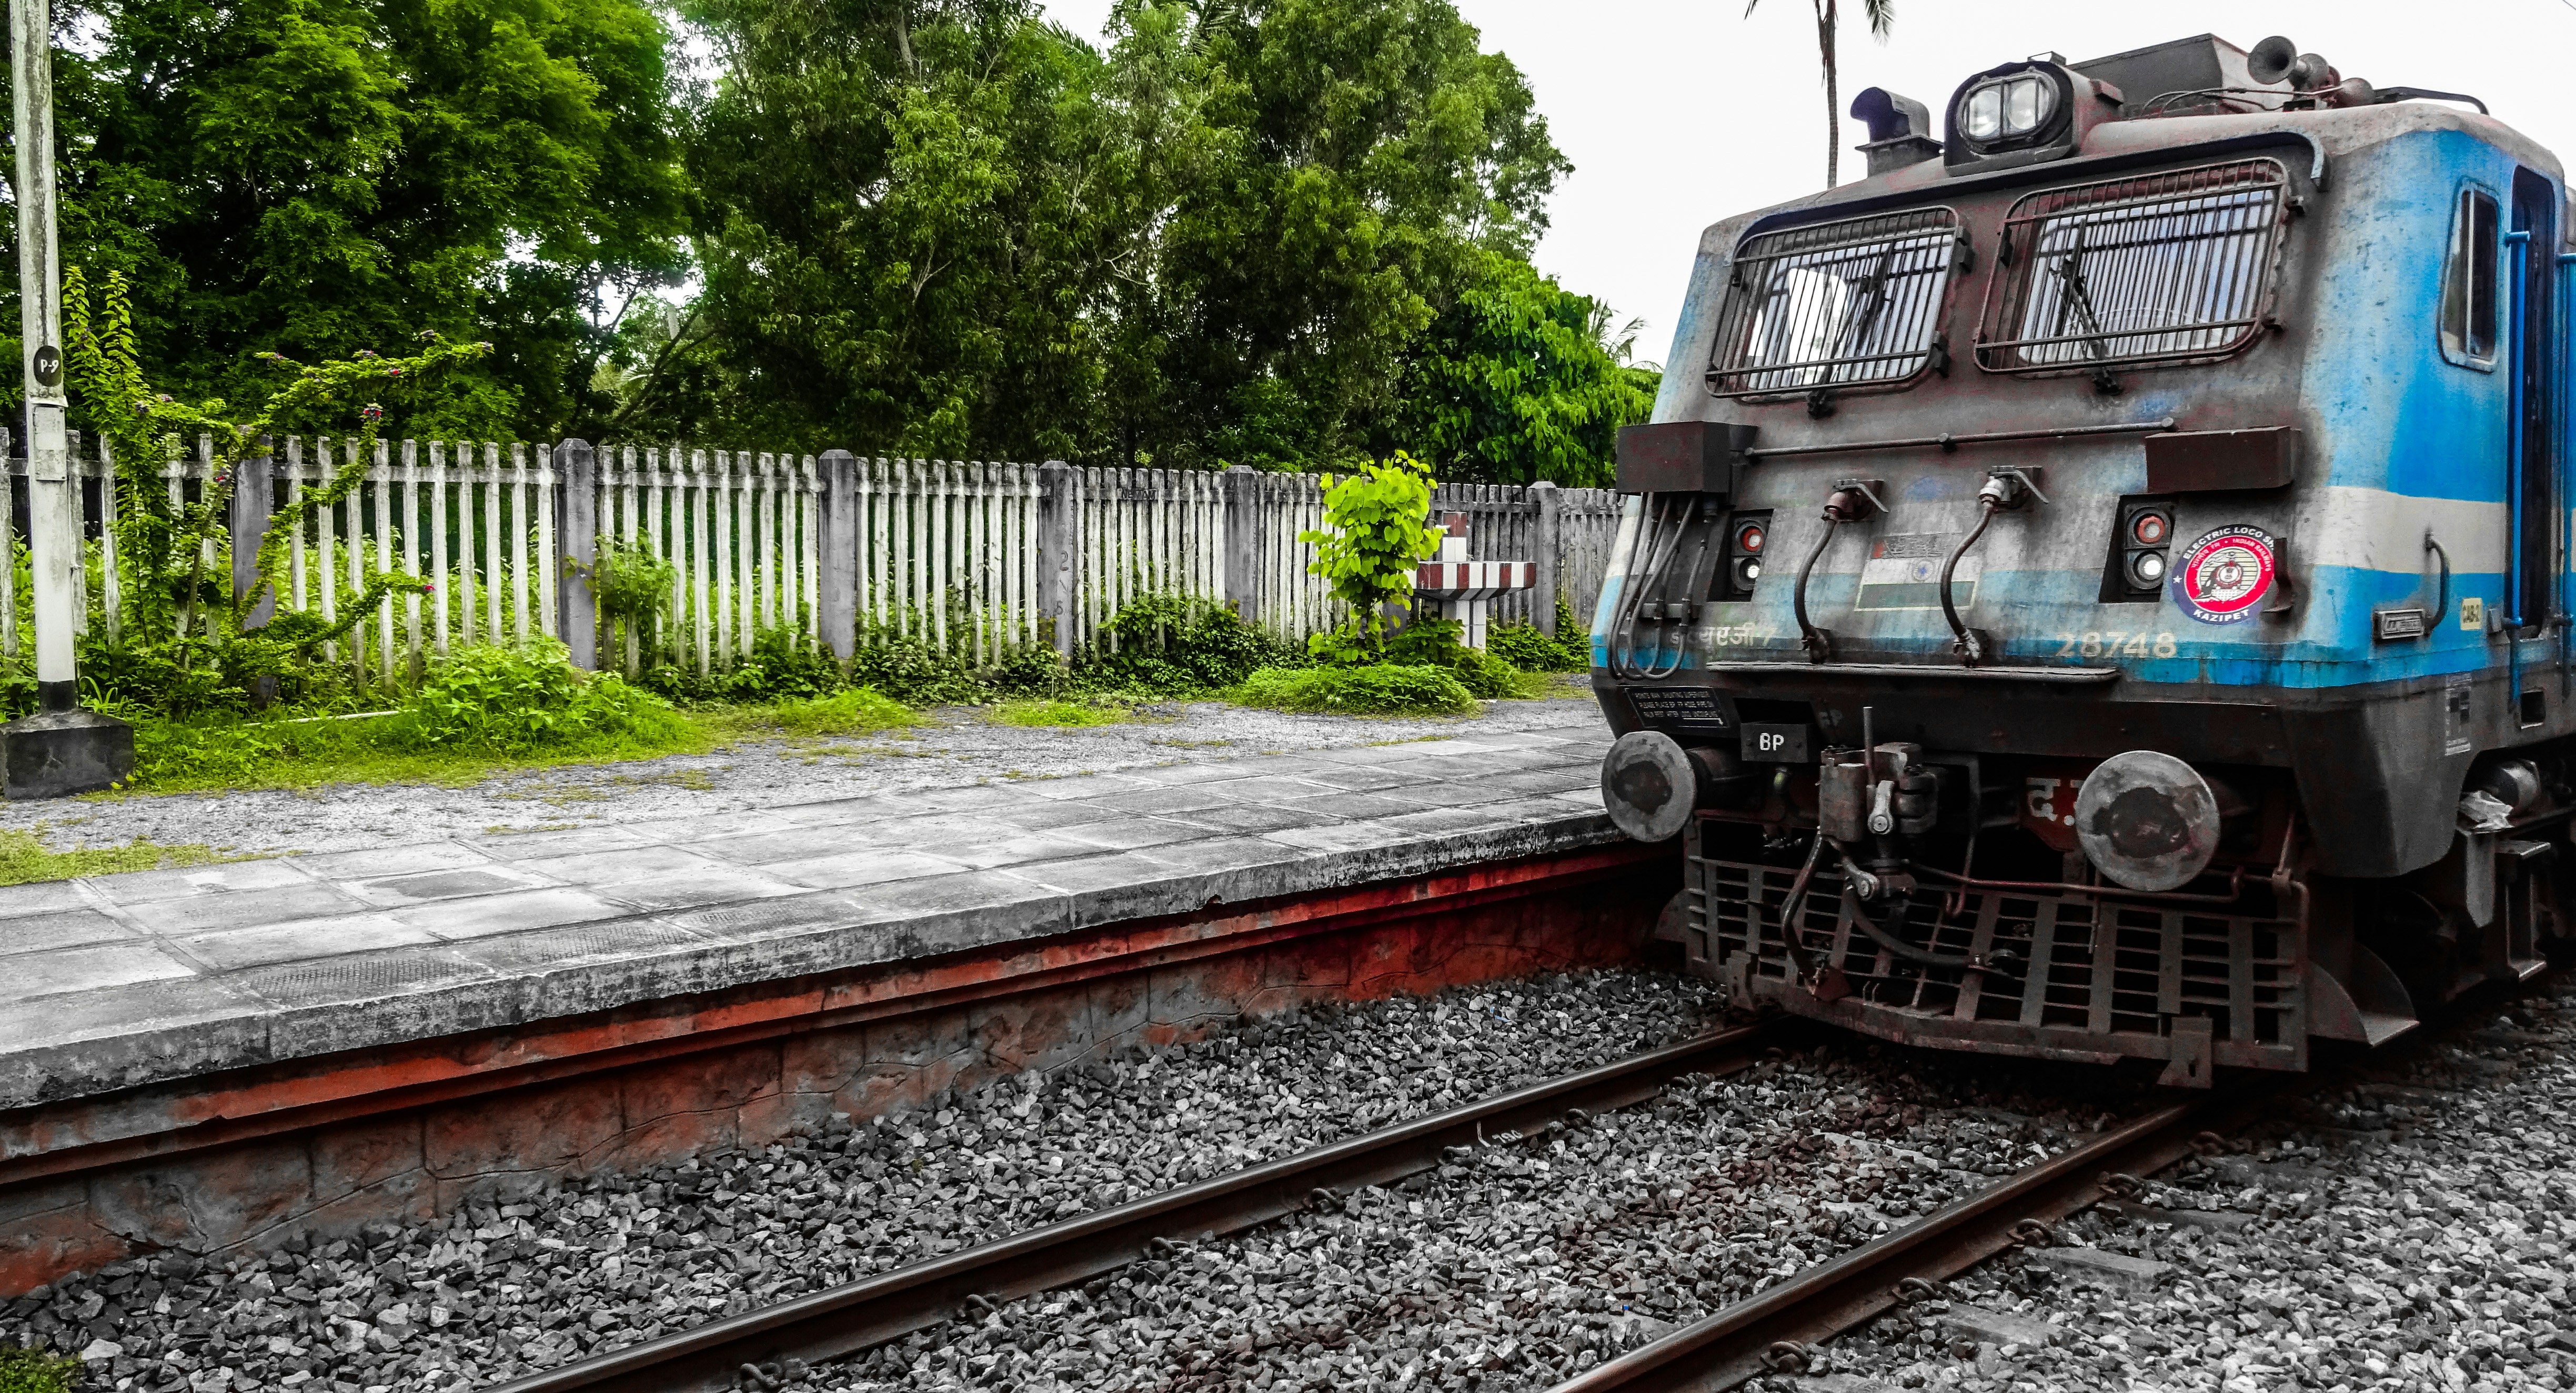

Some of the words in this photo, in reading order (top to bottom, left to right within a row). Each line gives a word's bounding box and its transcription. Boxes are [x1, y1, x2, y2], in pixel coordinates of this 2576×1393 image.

[2182, 528, 2231, 559] ELECTRIC
[2233, 527, 2263, 538] LOCO
[2262, 536, 2274, 550] SH
[2232, 538, 2255, 547] INDIAN
[2254, 545, 2271, 572] RAILWAYS
[2193, 609, 2249, 622] KAZIPET
[2055, 631, 2177, 658] 28748
[1760, 733, 1784, 751] BP
